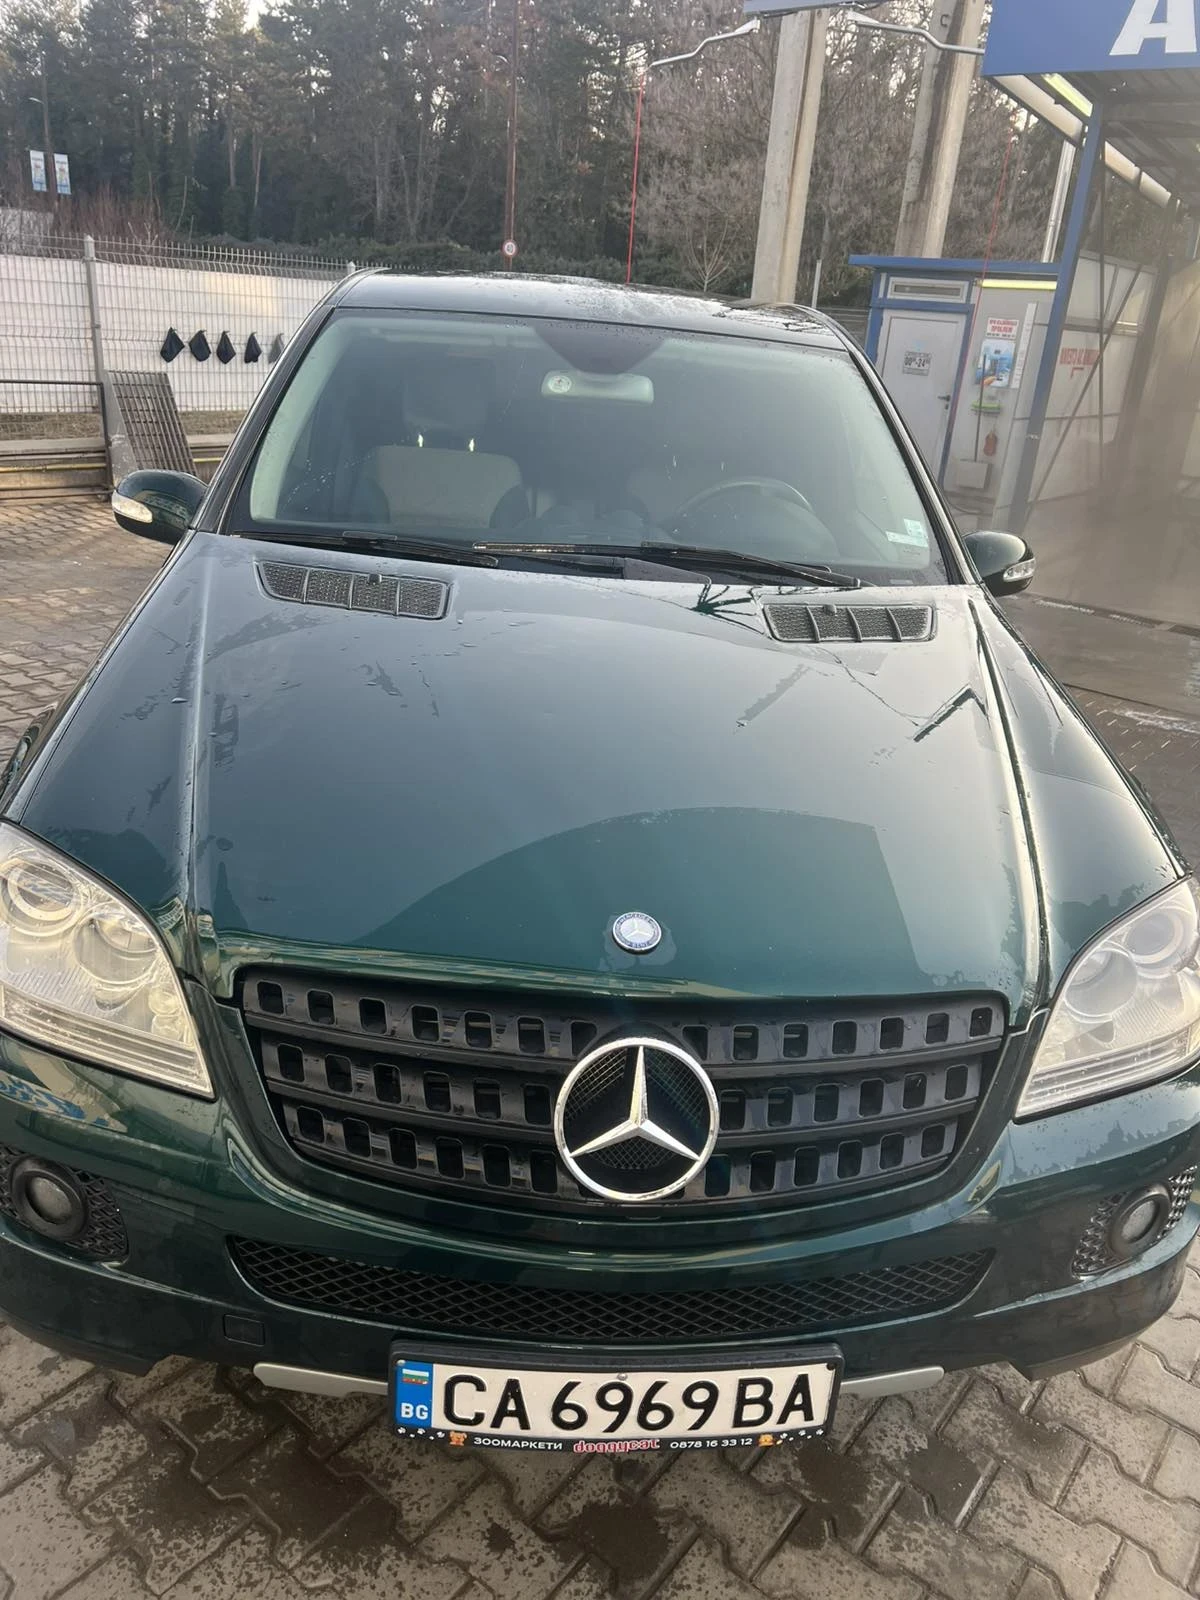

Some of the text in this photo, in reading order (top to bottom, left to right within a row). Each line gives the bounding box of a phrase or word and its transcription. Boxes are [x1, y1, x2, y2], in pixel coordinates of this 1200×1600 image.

[401, 1402, 429, 1420] BG
[551, 1380, 720, 1433] 6969
[473, 1436, 563, 1450] ЗООМАРКЕТИ
[669, 1437, 753, 1449] 0878 16 33 12
